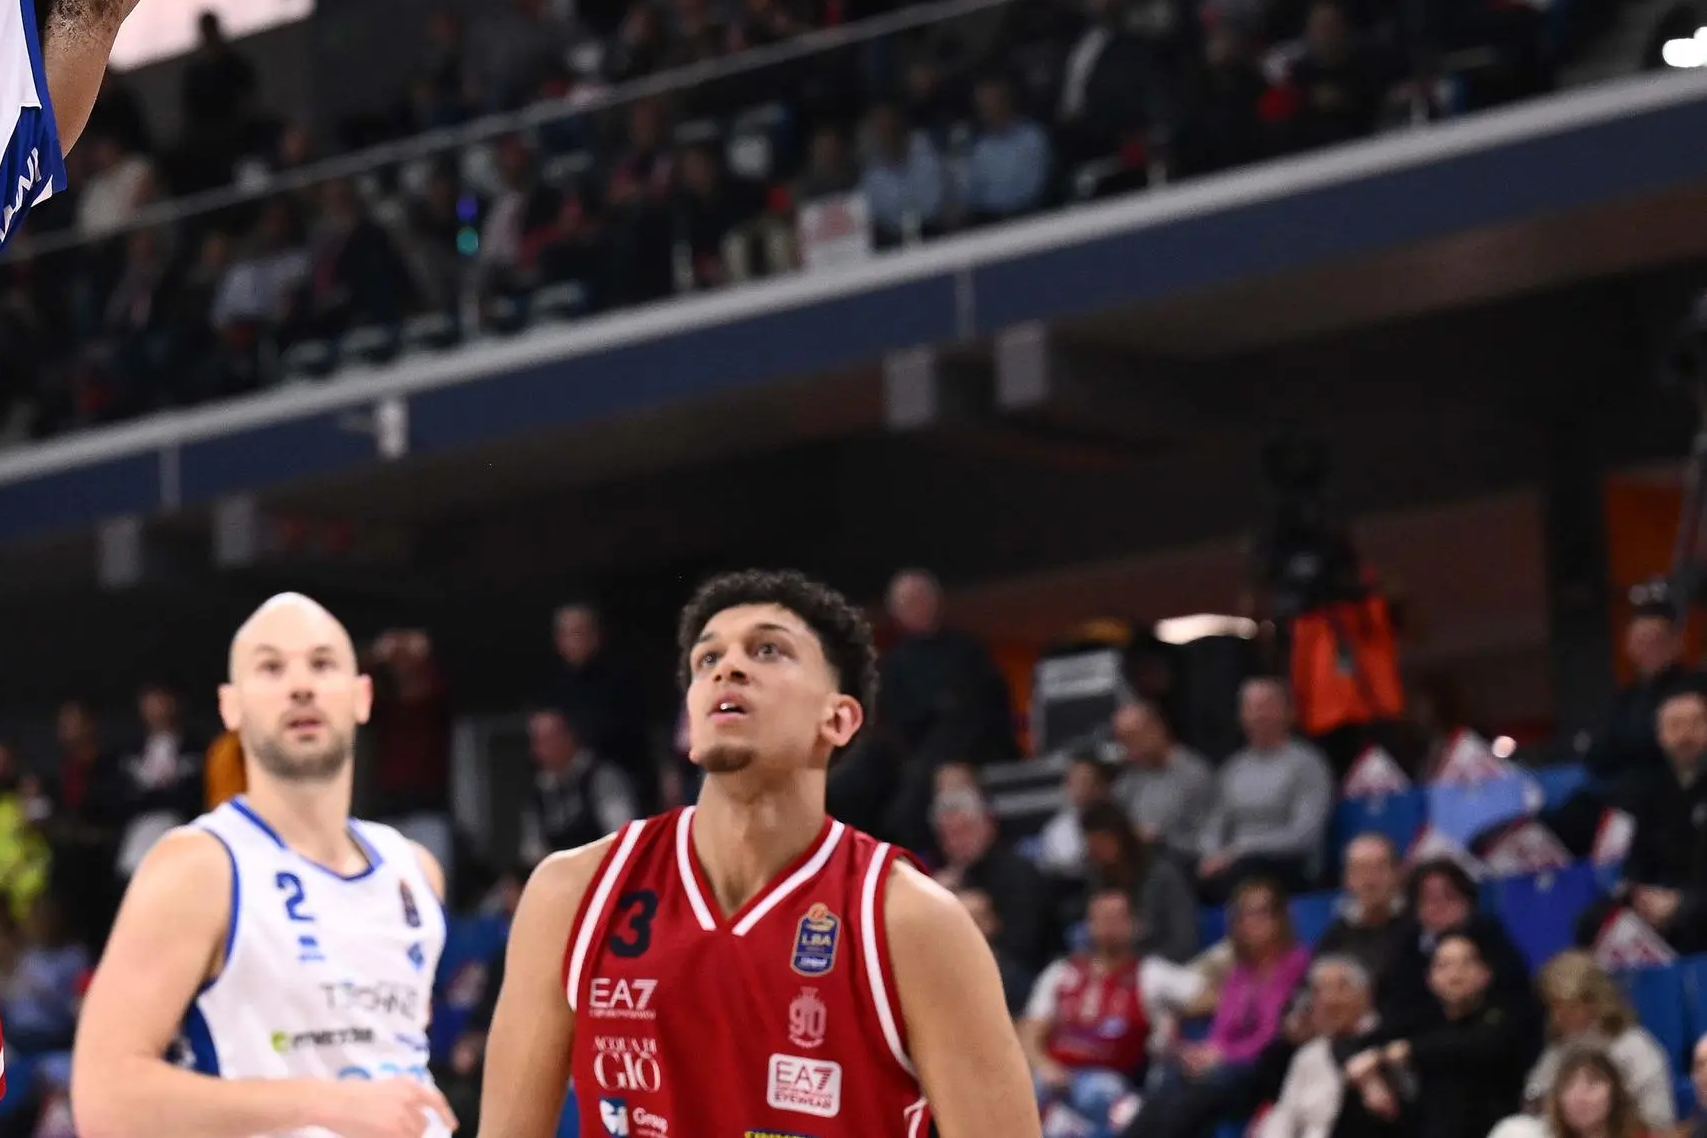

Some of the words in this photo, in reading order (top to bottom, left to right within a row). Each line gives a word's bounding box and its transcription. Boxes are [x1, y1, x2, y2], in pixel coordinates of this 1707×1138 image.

[275, 870, 315, 922] 2
[608, 888, 659, 958] 3
[589, 977, 659, 1009] EA7
[775, 1061, 834, 1090] EA7
